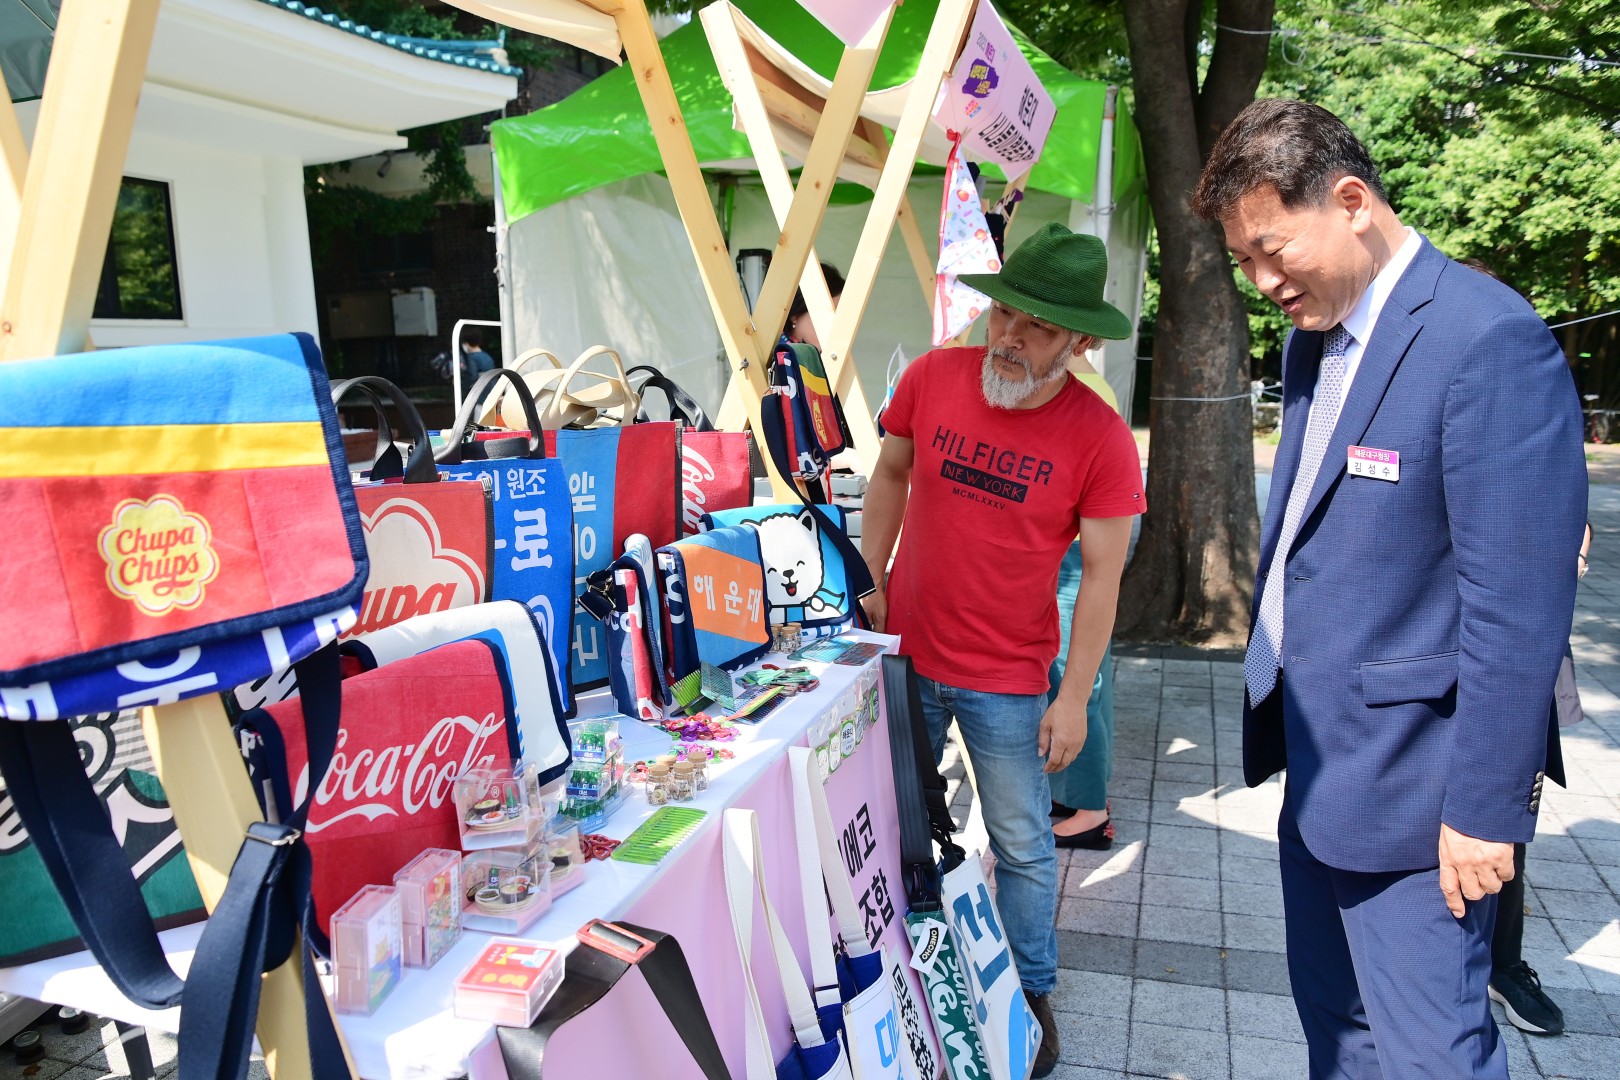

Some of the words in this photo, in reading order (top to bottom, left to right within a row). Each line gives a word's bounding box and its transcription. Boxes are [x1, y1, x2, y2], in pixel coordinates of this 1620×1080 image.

[932, 425, 1054, 486] HILFIGER
[506, 468, 547, 499] 원조
[944, 464, 980, 484] NEW
[983, 476, 1025, 500] YORK
[952, 487, 1006, 511] MCMLXXXV
[116, 526, 196, 557] Chupa
[120, 552, 200, 597] Chups
[340, 583, 458, 640] upa
[693, 575, 762, 623] 해운대
[838, 802, 877, 878] 에코
[921, 929, 938, 960] ONECHO
